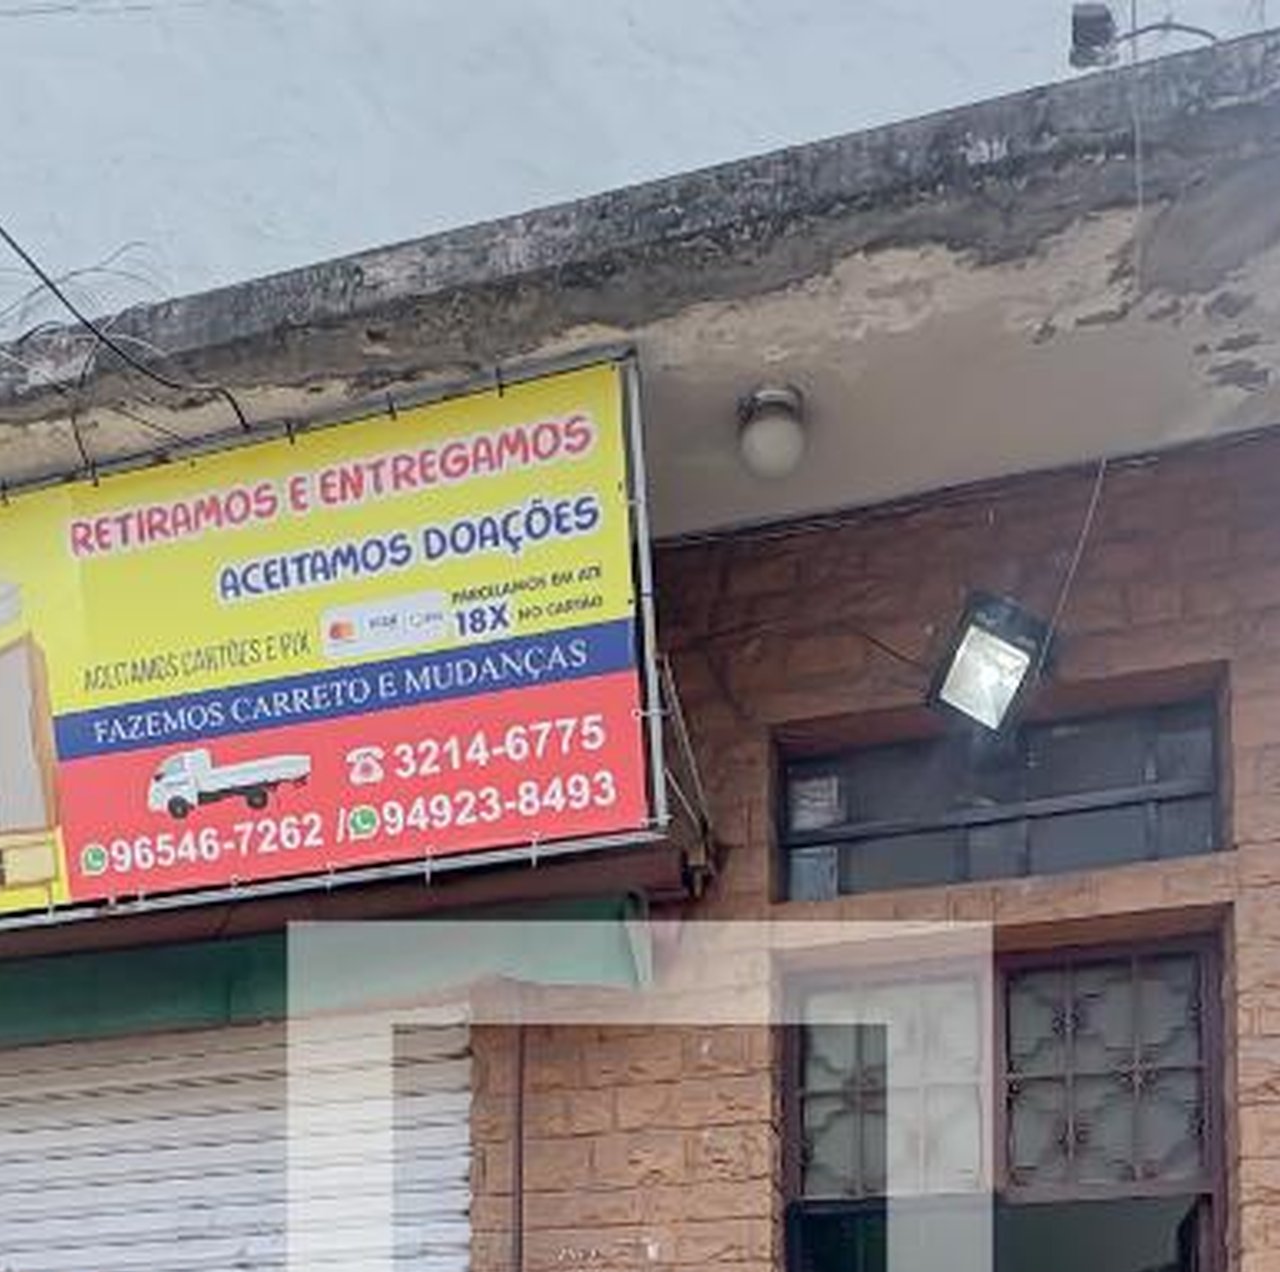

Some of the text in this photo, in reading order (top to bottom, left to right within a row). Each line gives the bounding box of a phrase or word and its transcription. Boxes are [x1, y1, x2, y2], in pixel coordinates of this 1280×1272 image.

[70, 415, 593, 558] RETIRAMOS E ENTREGAMOS
[219, 495, 599, 600] ACEITAMOS DOAÇÕES
[265, 634, 278, 660] E
[454, 604, 510, 637] 18X
[518, 606, 543, 622] NO
[93, 640, 590, 743] FAZEMOS CARRETO E MUDANÇAS
[395, 714, 607, 778] 3214-6775
[111, 812, 324, 873] 96546-7262
[381, 771, 617, 837] 94923-8493
